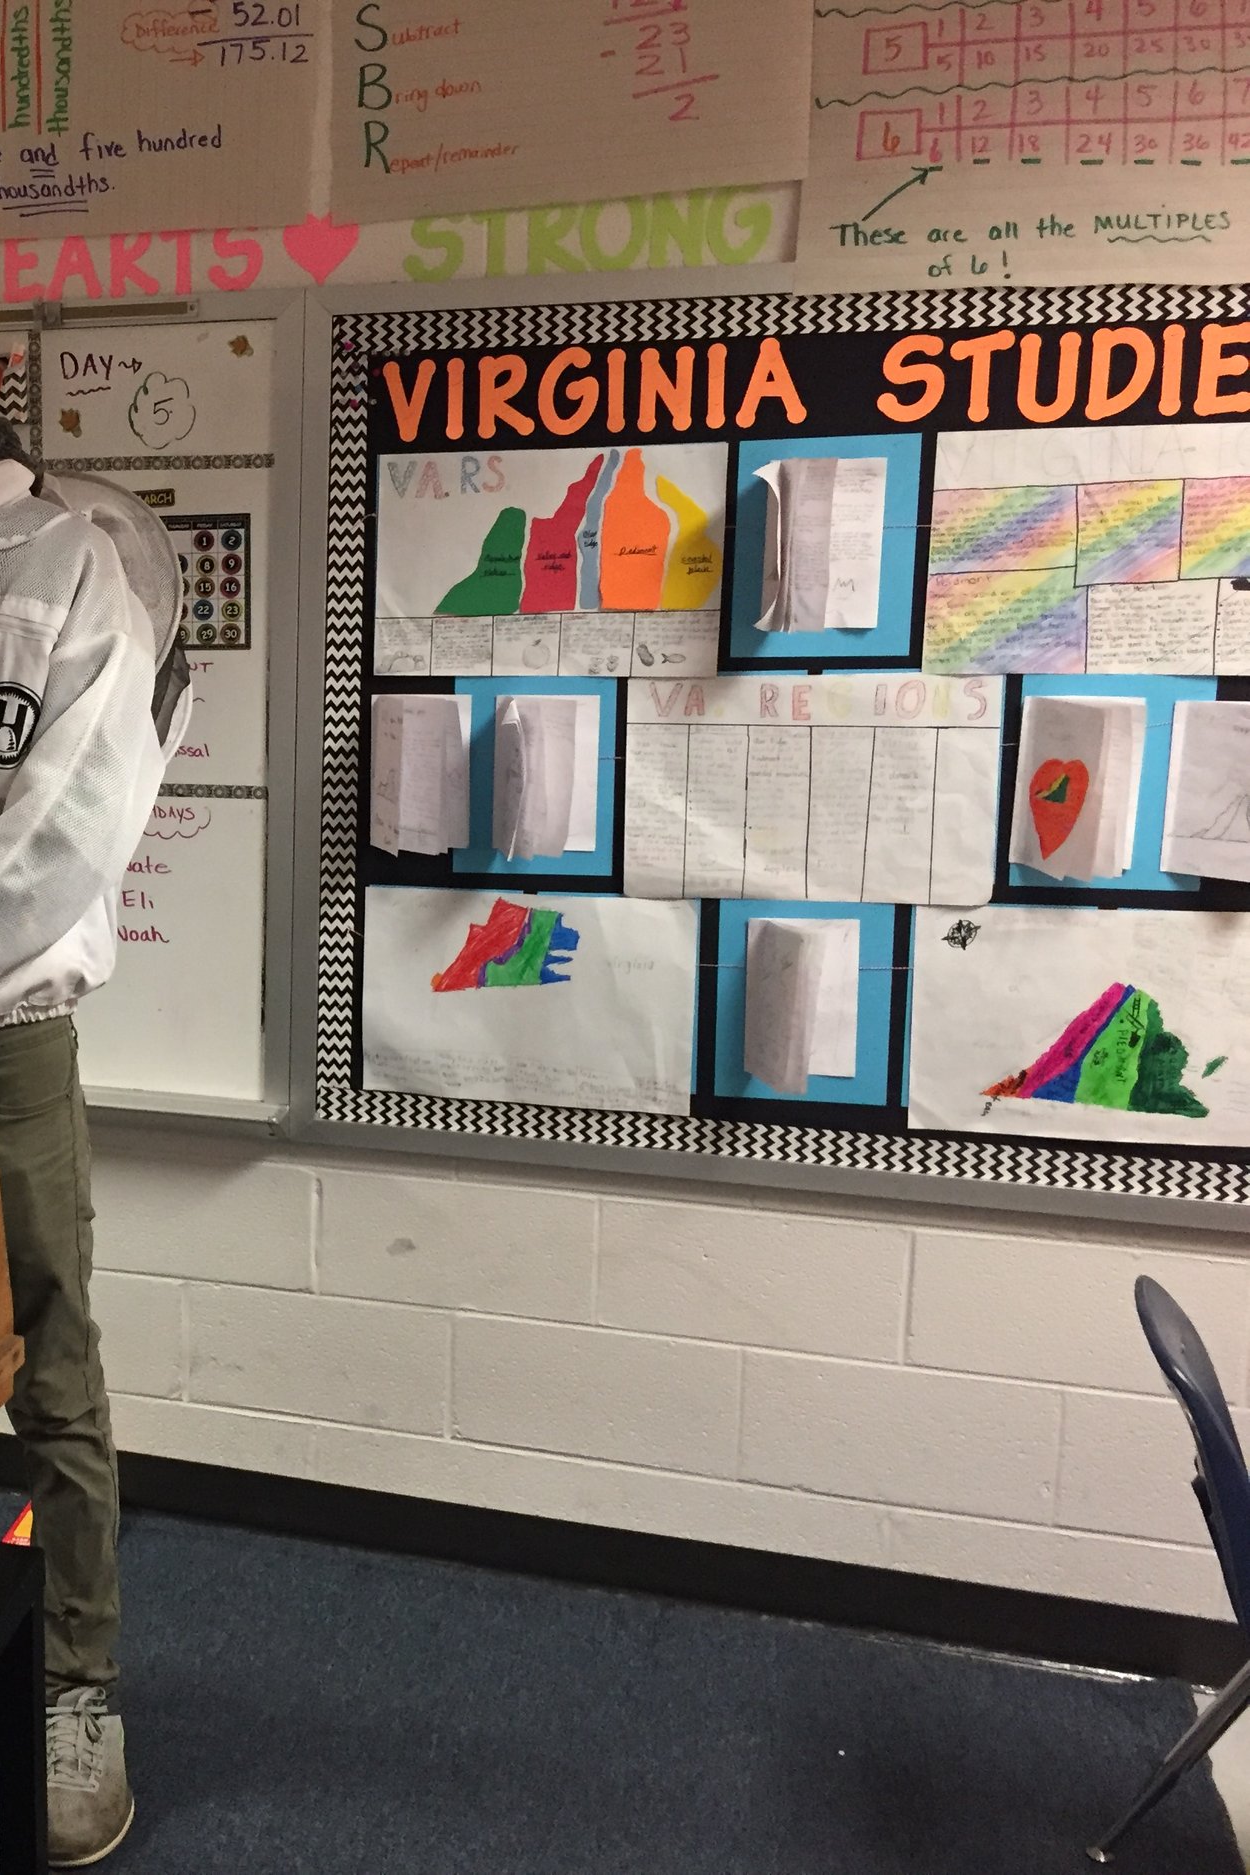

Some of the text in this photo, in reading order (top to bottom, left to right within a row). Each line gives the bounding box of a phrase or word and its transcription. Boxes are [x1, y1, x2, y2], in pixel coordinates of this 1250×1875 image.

[135, 18, 220, 38] Difference
[233, 1, 301, 28] 52.01
[974, 13, 993, 31] 2
[1029, 6, 1045, 28] 3
[220, 40, 310, 67] 175.12
[884, 35, 902, 62] 5
[1083, 41, 1109, 59] 20
[1180, 34, 1211, 52] 30
[8, 5, 32, 129] hundredths
[435, 78, 483, 100] down
[973, 100, 993, 122] 2
[1029, 90, 1045, 115] 3
[1084, 90, 1105, 114] 4
[1135, 83, 1158, 108] 5
[1188, 79, 1204, 105] 6
[668, 93, 700, 121] 2
[19, 142, 58, 167] and
[80, 131, 127, 161] five
[137, 124, 223, 152] hundred
[882, 121, 901, 153] 6
[970, 136, 991, 154] 12
[1075, 133, 1113, 154] 24
[1133, 134, 1159, 153] 30
[1182, 132, 1210, 152] 36
[402, 183, 773, 283] STRONG
[829, 210, 1231, 247] These are all the MULTIPLES
[927, 255, 952, 278] of
[59, 351, 114, 381] DAY
[383, 337, 808, 442] VIRGINIA
[200, 581, 238, 593] 15 16
[197, 605, 239, 616] 22 23
[201, 628, 238, 641] 29 30
[121, 889, 155, 910] Eli
